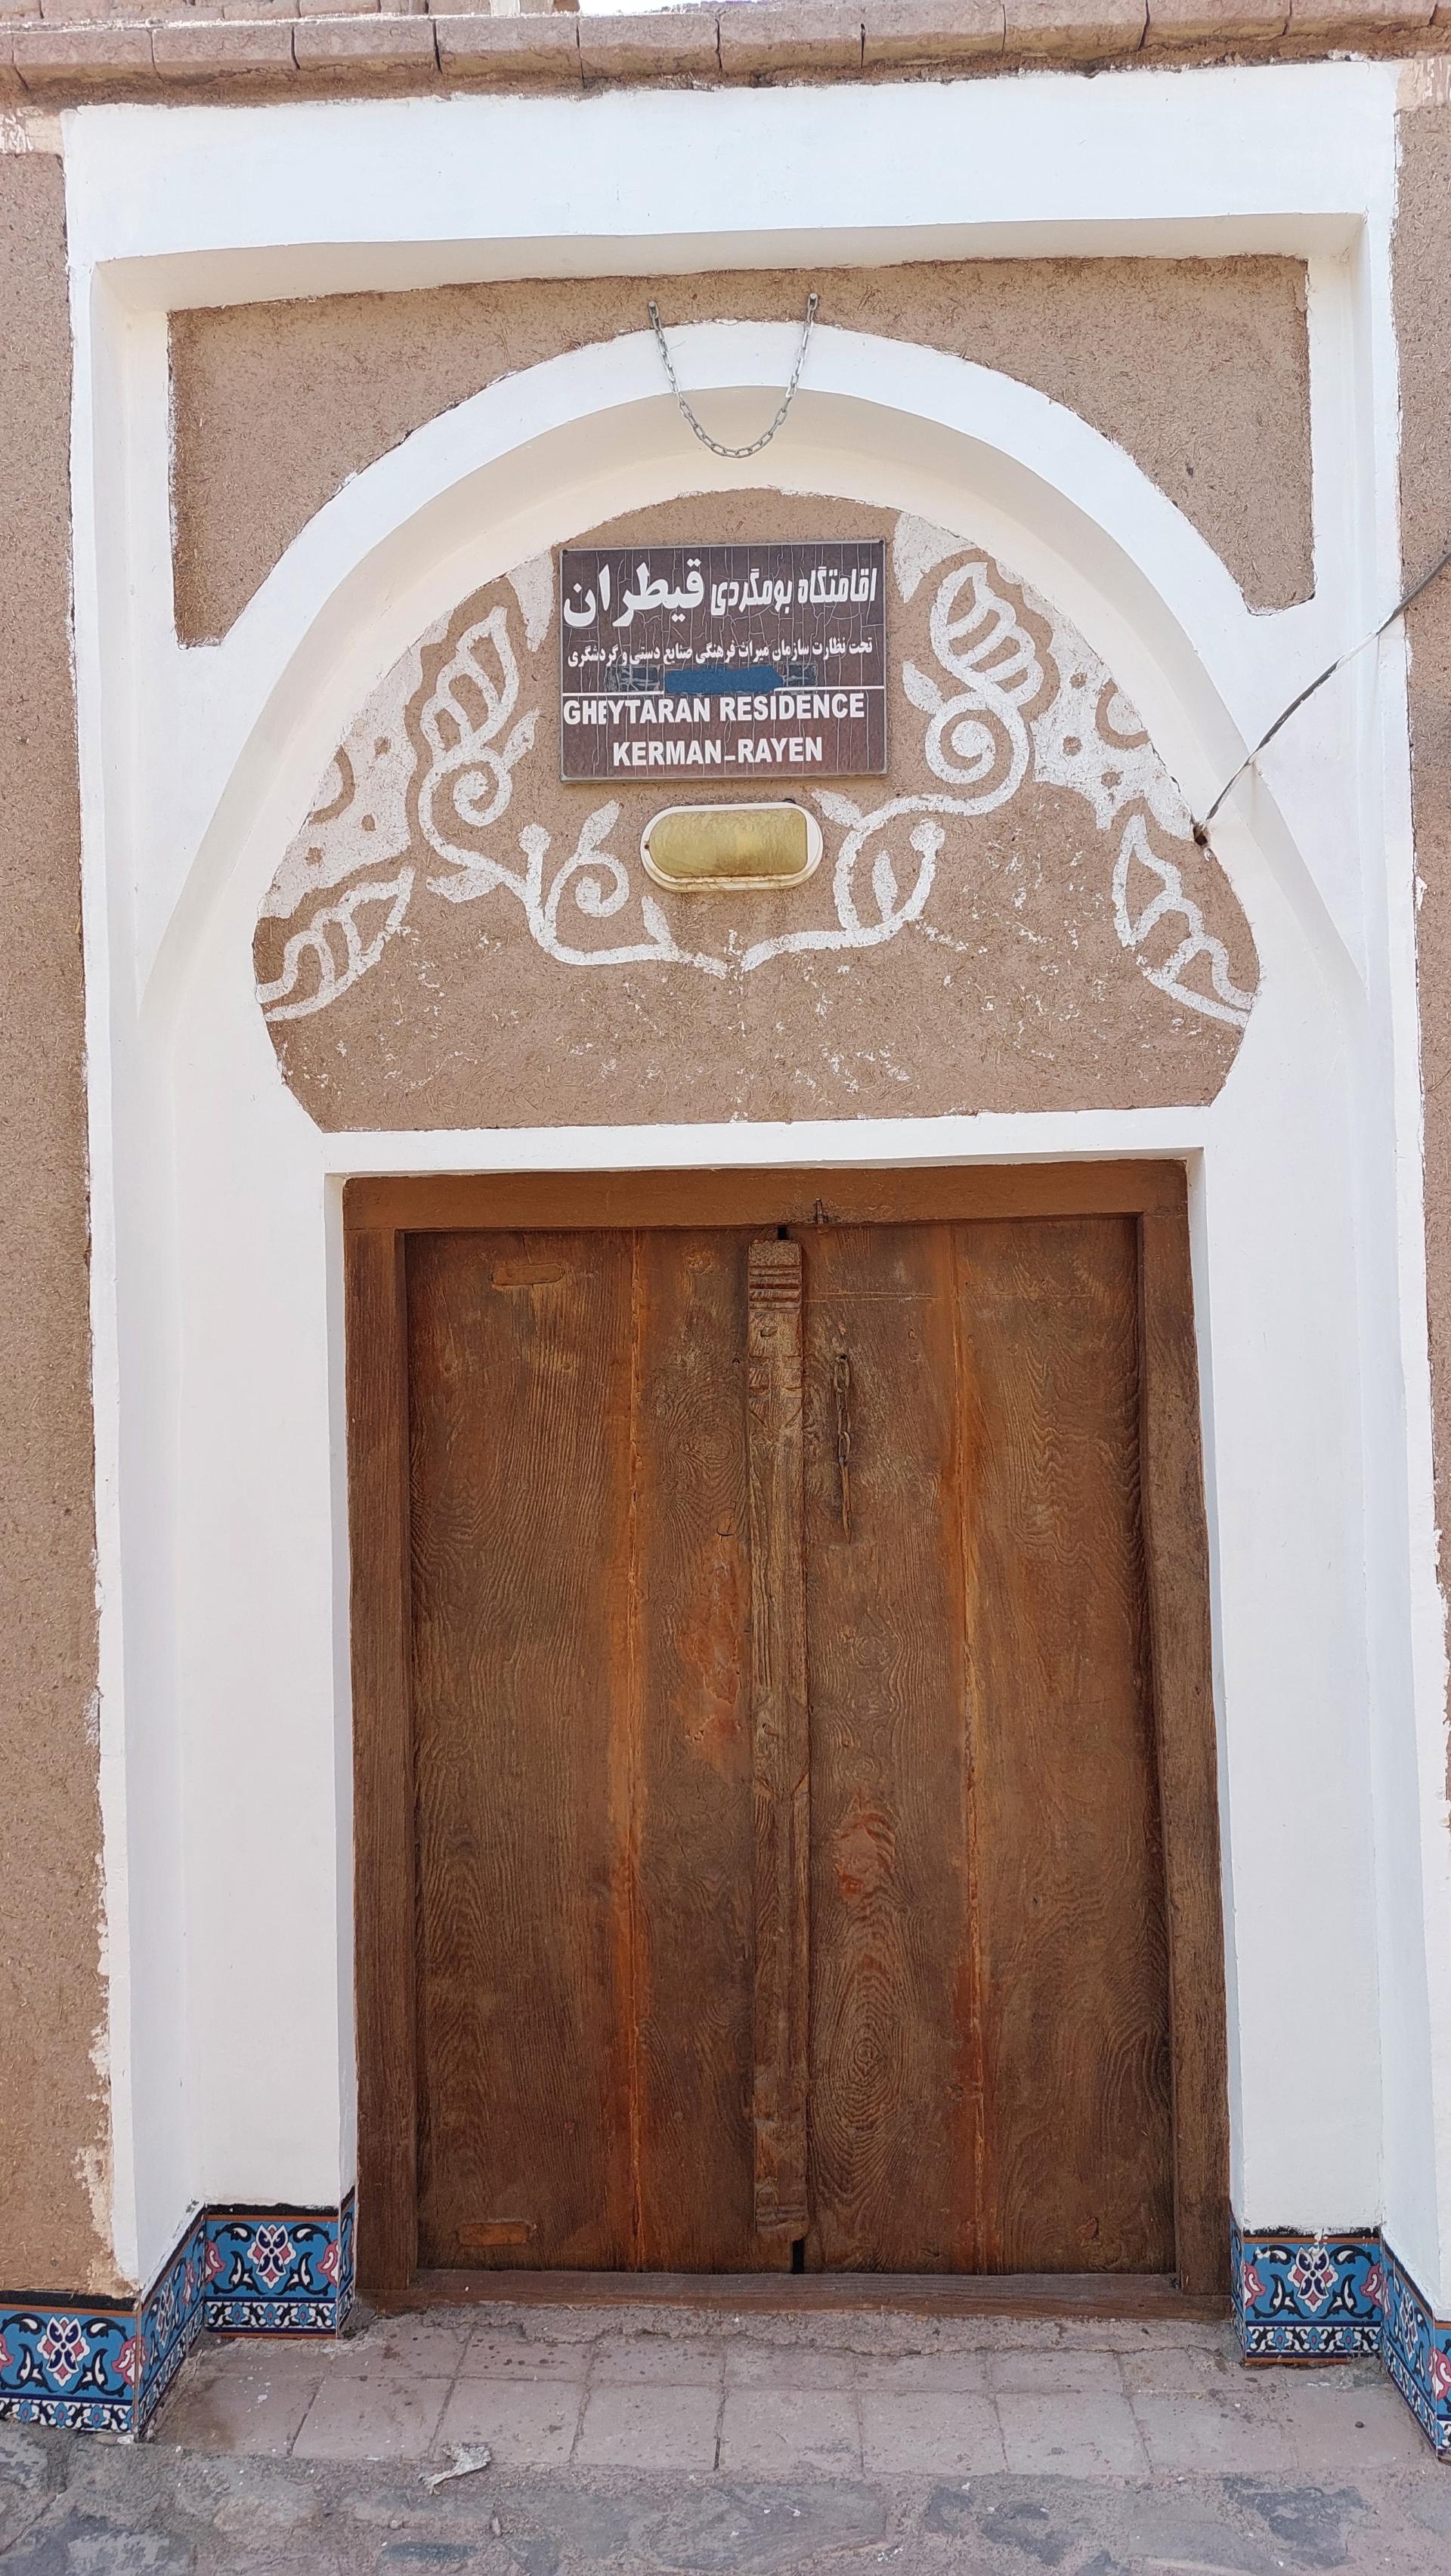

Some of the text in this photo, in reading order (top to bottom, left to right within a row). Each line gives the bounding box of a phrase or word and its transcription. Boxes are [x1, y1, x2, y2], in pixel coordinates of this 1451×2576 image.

[563, 558, 877, 627] اقامتگاه بومگردی قیطران
[568, 636, 873, 668] تحت نظارت سازمان میراث فرهنگی صنایع دستی و گردشگری
[563, 692, 865, 725] GHEYTARAN RESIDENCE
